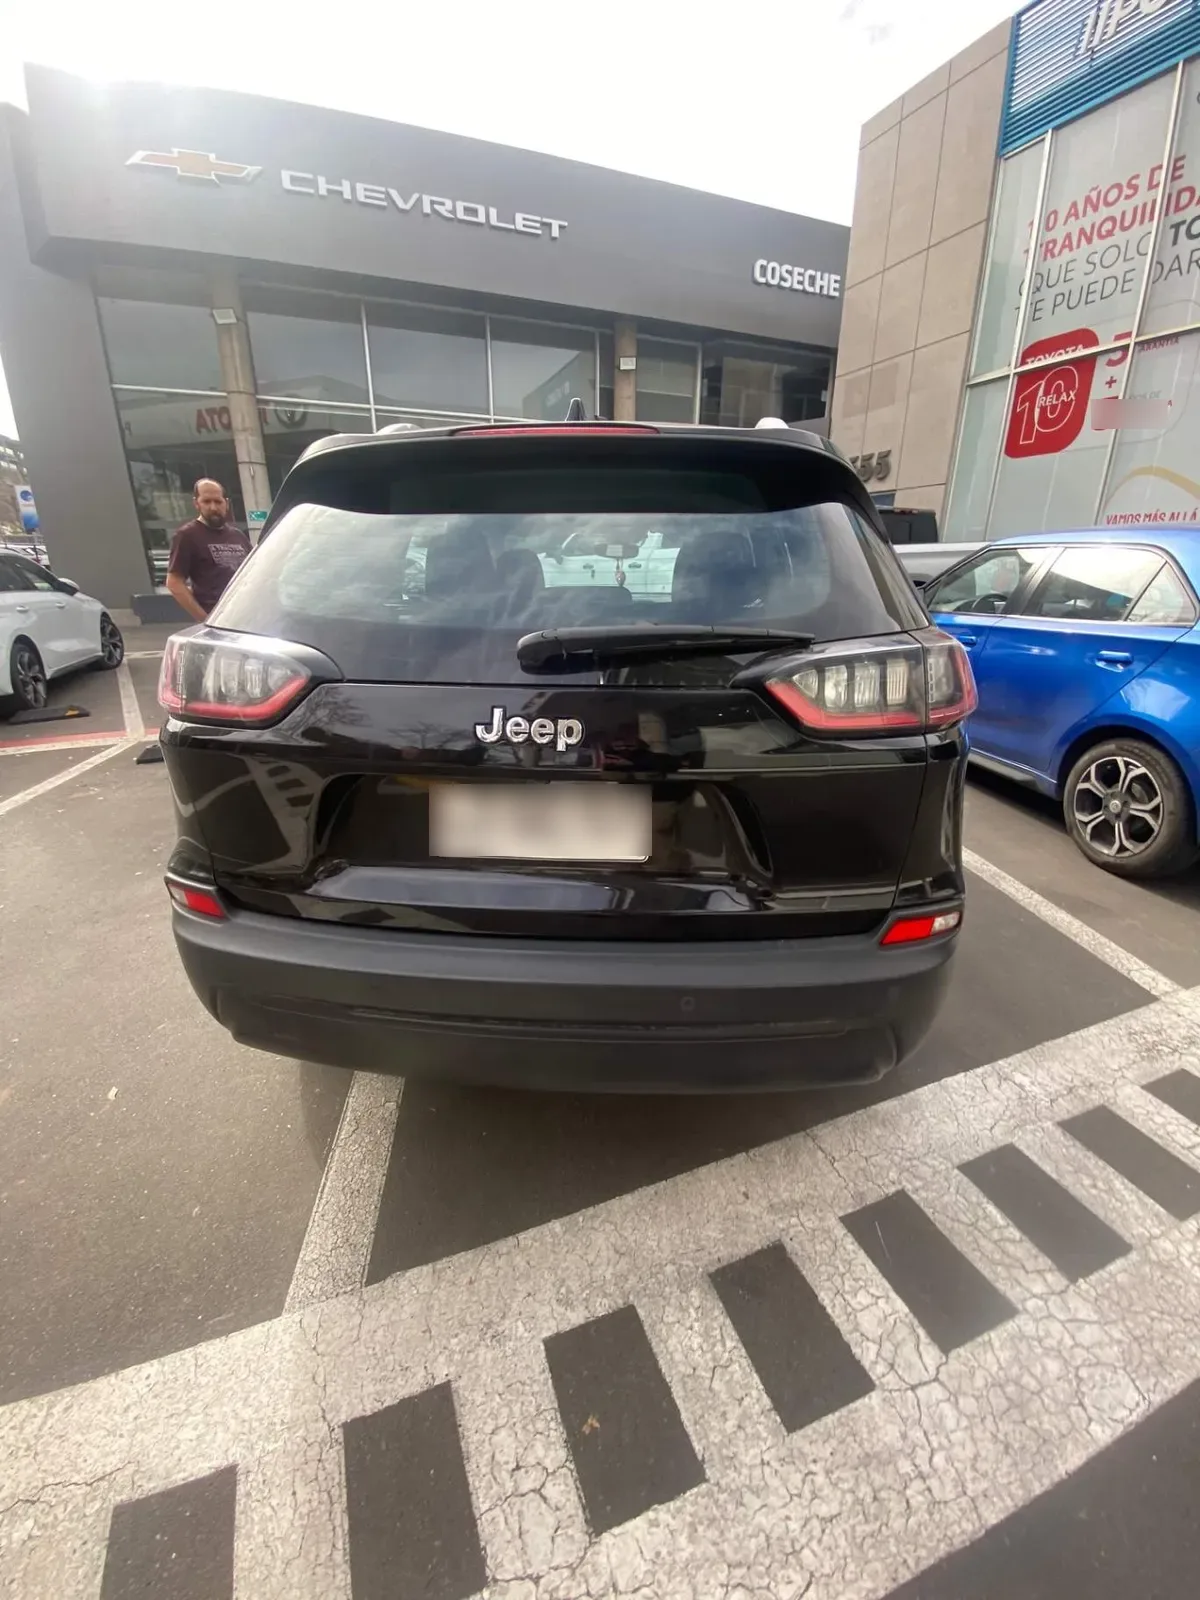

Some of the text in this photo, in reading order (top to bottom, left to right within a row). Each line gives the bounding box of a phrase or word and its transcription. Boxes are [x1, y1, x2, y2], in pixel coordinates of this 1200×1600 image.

[281, 169, 568, 239] CHEVROLET
[1063, 173, 1140, 227] AÑOS
[1147, 154, 1187, 192] DE
[753, 259, 841, 297] COSECHE
[1018, 258, 1077, 297] QUE
[1084, 231, 1153, 276] SOLO
[1051, 268, 1136, 316] PUEDE
[1016, 365, 1079, 445] 10
[1038, 389, 1077, 409] RELAX
[1106, 512, 1141, 526] VAMOS
[1142, 508, 1167, 523] MÁS
[475, 707, 583, 752] Jeep
